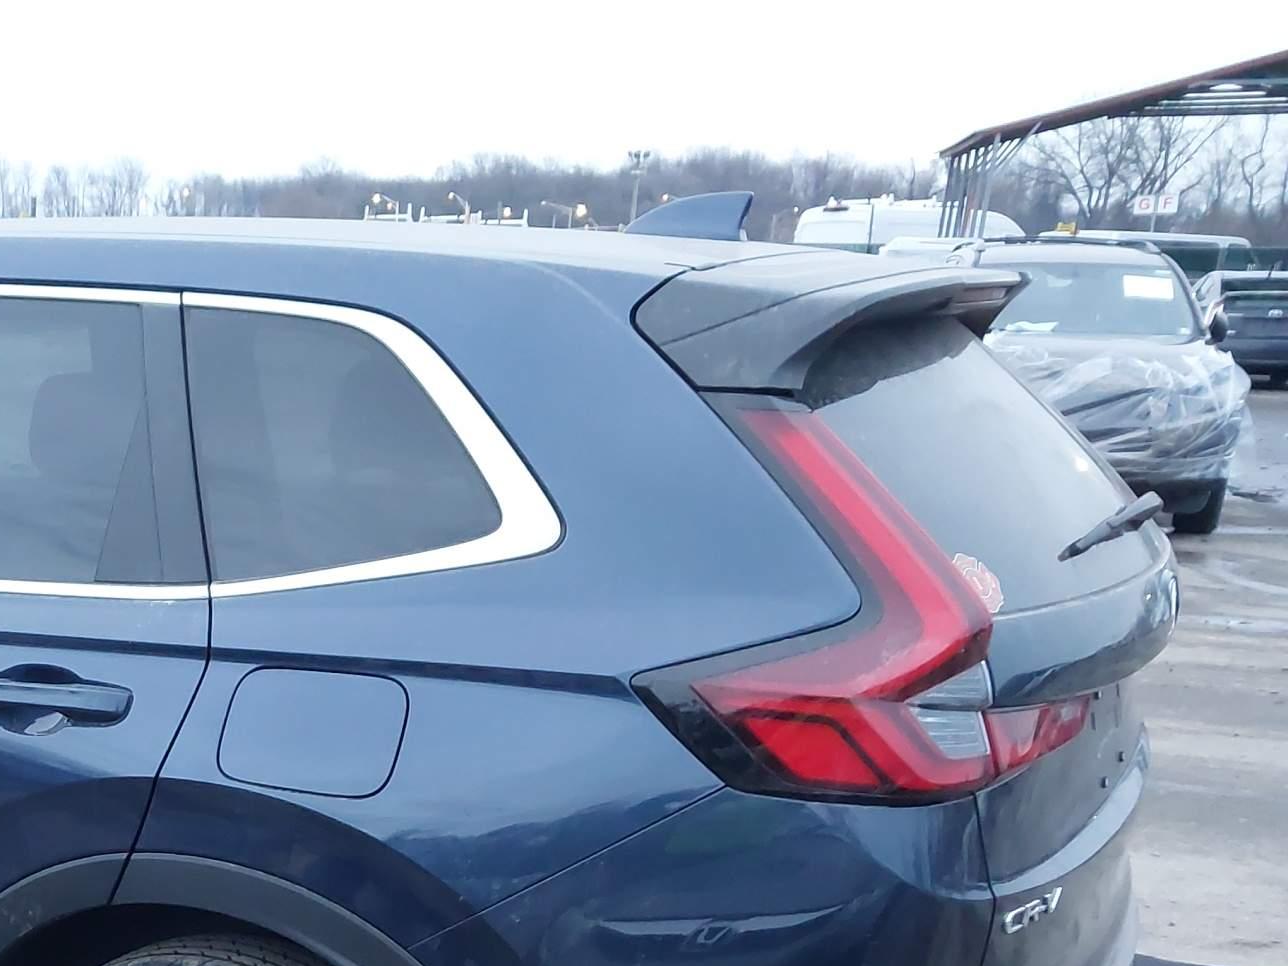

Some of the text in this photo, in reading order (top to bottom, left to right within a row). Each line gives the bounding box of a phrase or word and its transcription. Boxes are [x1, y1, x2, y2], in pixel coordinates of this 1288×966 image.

[1138, 198, 1150, 210] G
[1163, 196, 1174, 209] F
[1003, 886, 1063, 935] CR-V
